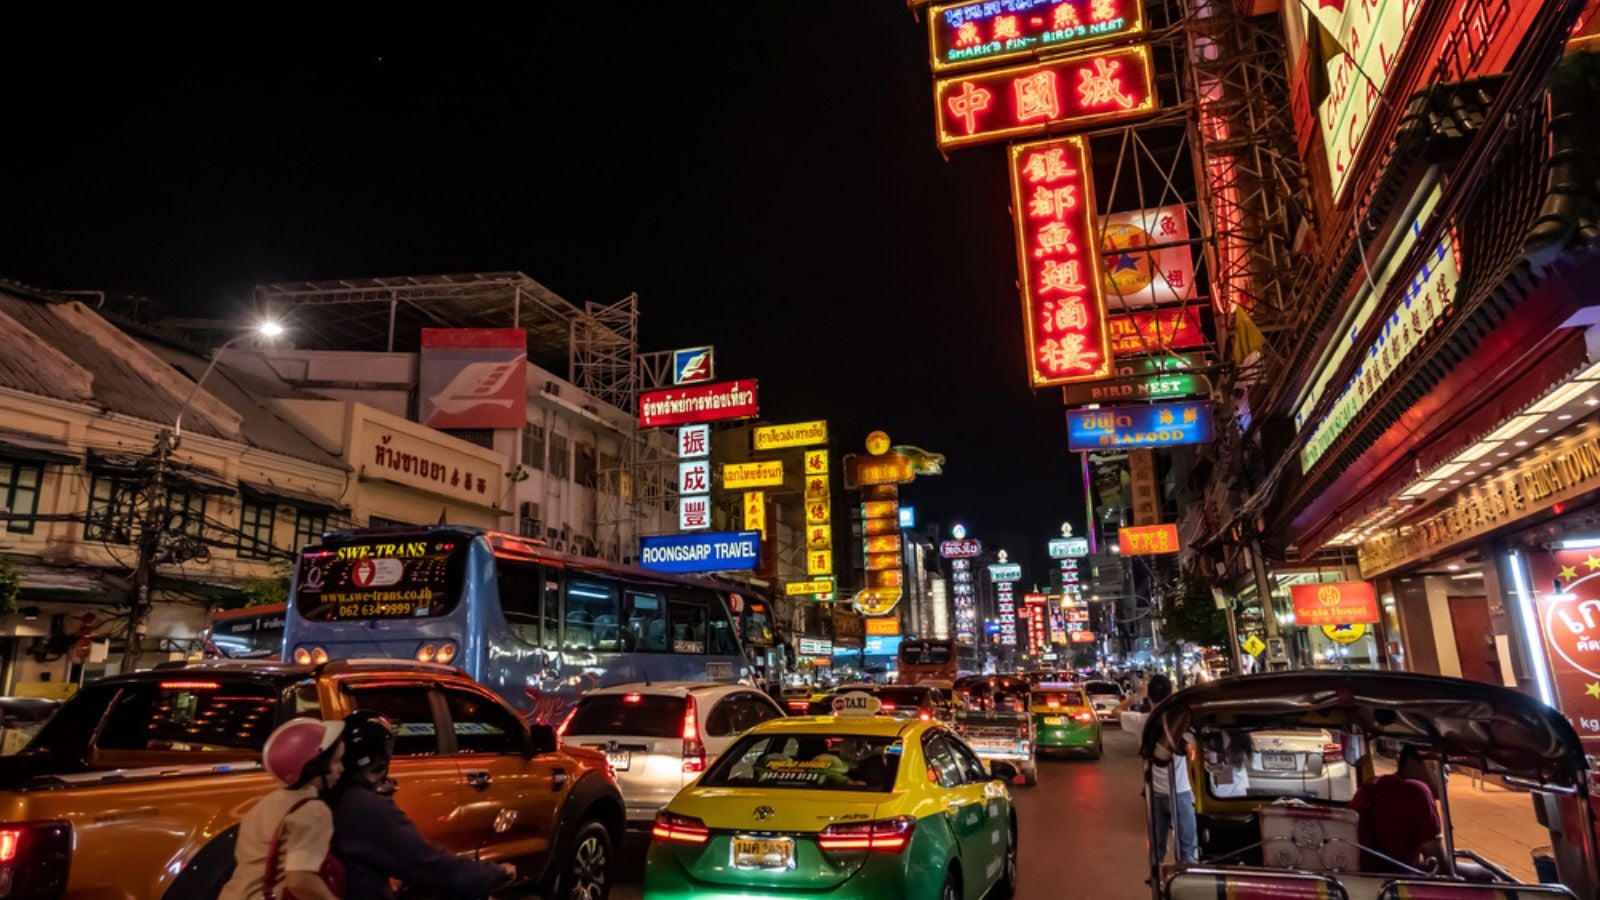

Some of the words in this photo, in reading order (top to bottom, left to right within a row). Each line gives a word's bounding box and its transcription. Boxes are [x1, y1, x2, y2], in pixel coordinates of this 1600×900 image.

[948, 41, 1001, 60] SHARK'S
[1043, 25, 1086, 43] BIRD'S
[1090, 17, 1124, 32] NEST
[1327, 27, 1361, 130] CHINA
[949, 57, 1133, 134] 中國城
[1022, 148, 1099, 373] 銀都魚翅酒樓
[1091, 386, 1133, 398] BIRD
[1137, 381, 1182, 394] NEST
[1099, 430, 1185, 445] SEAFOOD
[375, 434, 447, 483] ห้างขายยา
[1524, 458, 1565, 501] CHINA
[336, 542, 428, 561] SWE-TRANS
[643, 545, 710, 564] ROONGSARP
[714, 541, 757, 559] TRAVEL
[320, 586, 433, 603] www.swe-trans.co.th
[340, 605, 359, 617] 062
[1299, 607, 1328, 617] Scala
[1331, 605, 1368, 616] Hostel
[844, 697, 867, 709] TAXI
